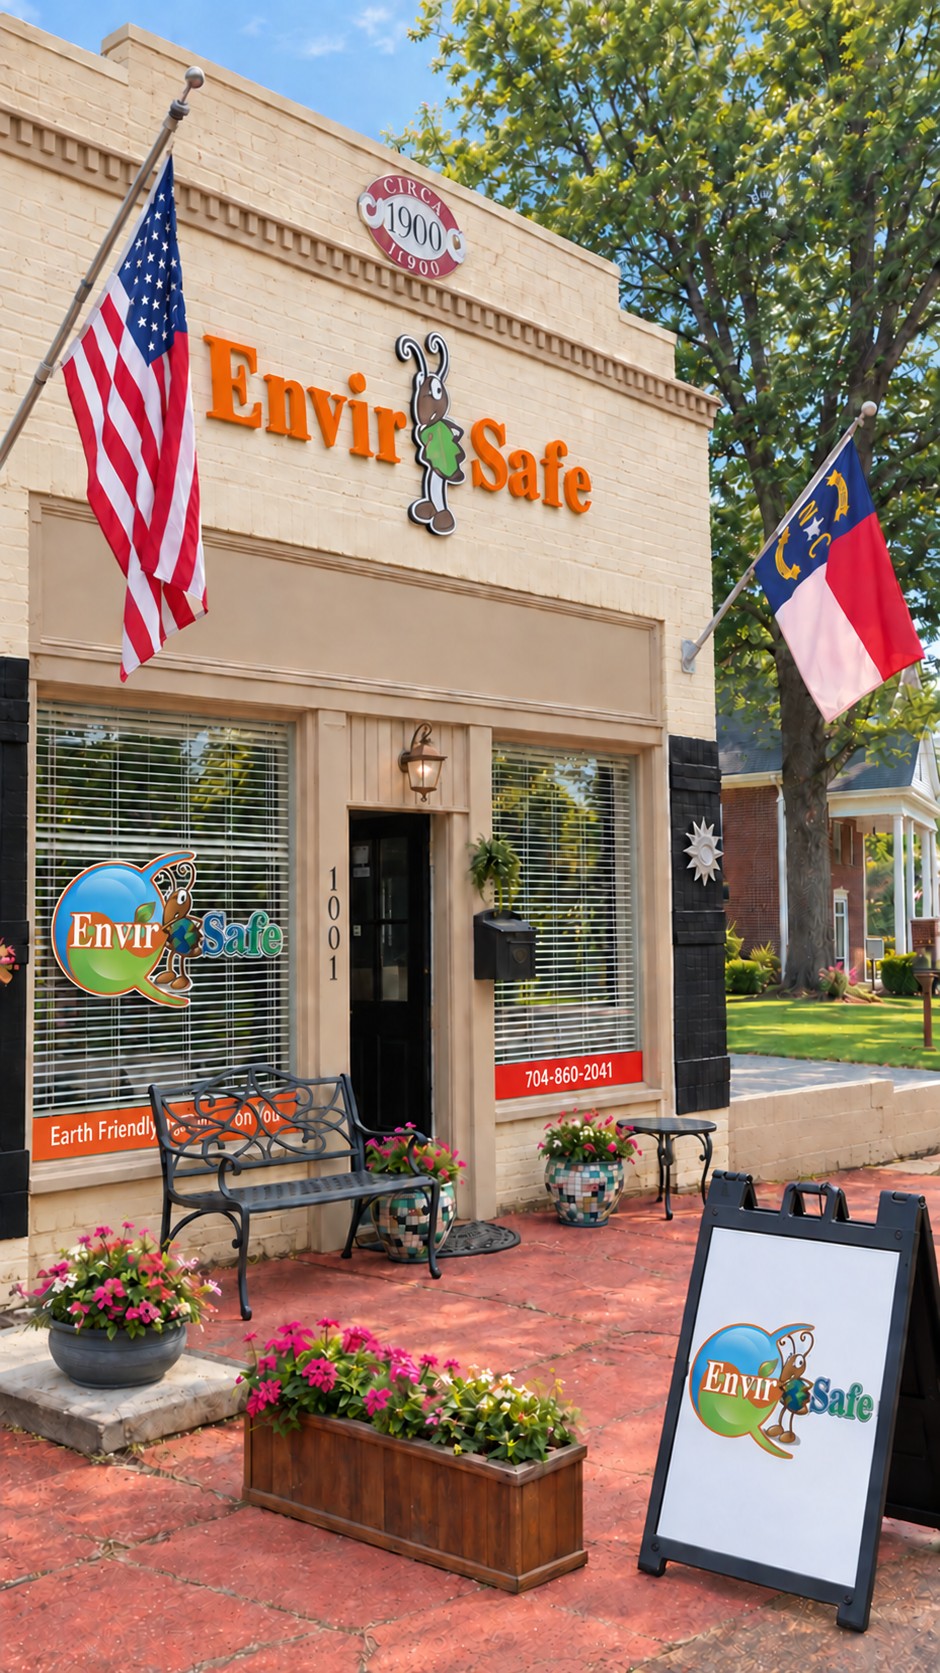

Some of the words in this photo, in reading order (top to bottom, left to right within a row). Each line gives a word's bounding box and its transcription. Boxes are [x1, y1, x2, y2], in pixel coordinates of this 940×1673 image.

[383, 178, 441, 216] CIRCA
[387, 202, 442, 252] 1900
[203, 334, 407, 464] Envir
[471, 417, 592, 514] Safe
[798, 500, 818, 526] N
[808, 532, 832, 558] C
[69, 912, 160, 950] Envir
[201, 910, 284, 959] Safe
[327, 866, 340, 981] 1001
[525, 1061, 613, 1088] 704-860-2041
[50, 1123, 93, 1147] Earth
[98, 1115, 157, 1141] Friendly
[234, 1111, 252, 1127] on
[702, 1360, 778, 1402] Envir
[809, 1376, 874, 1423] Safe
